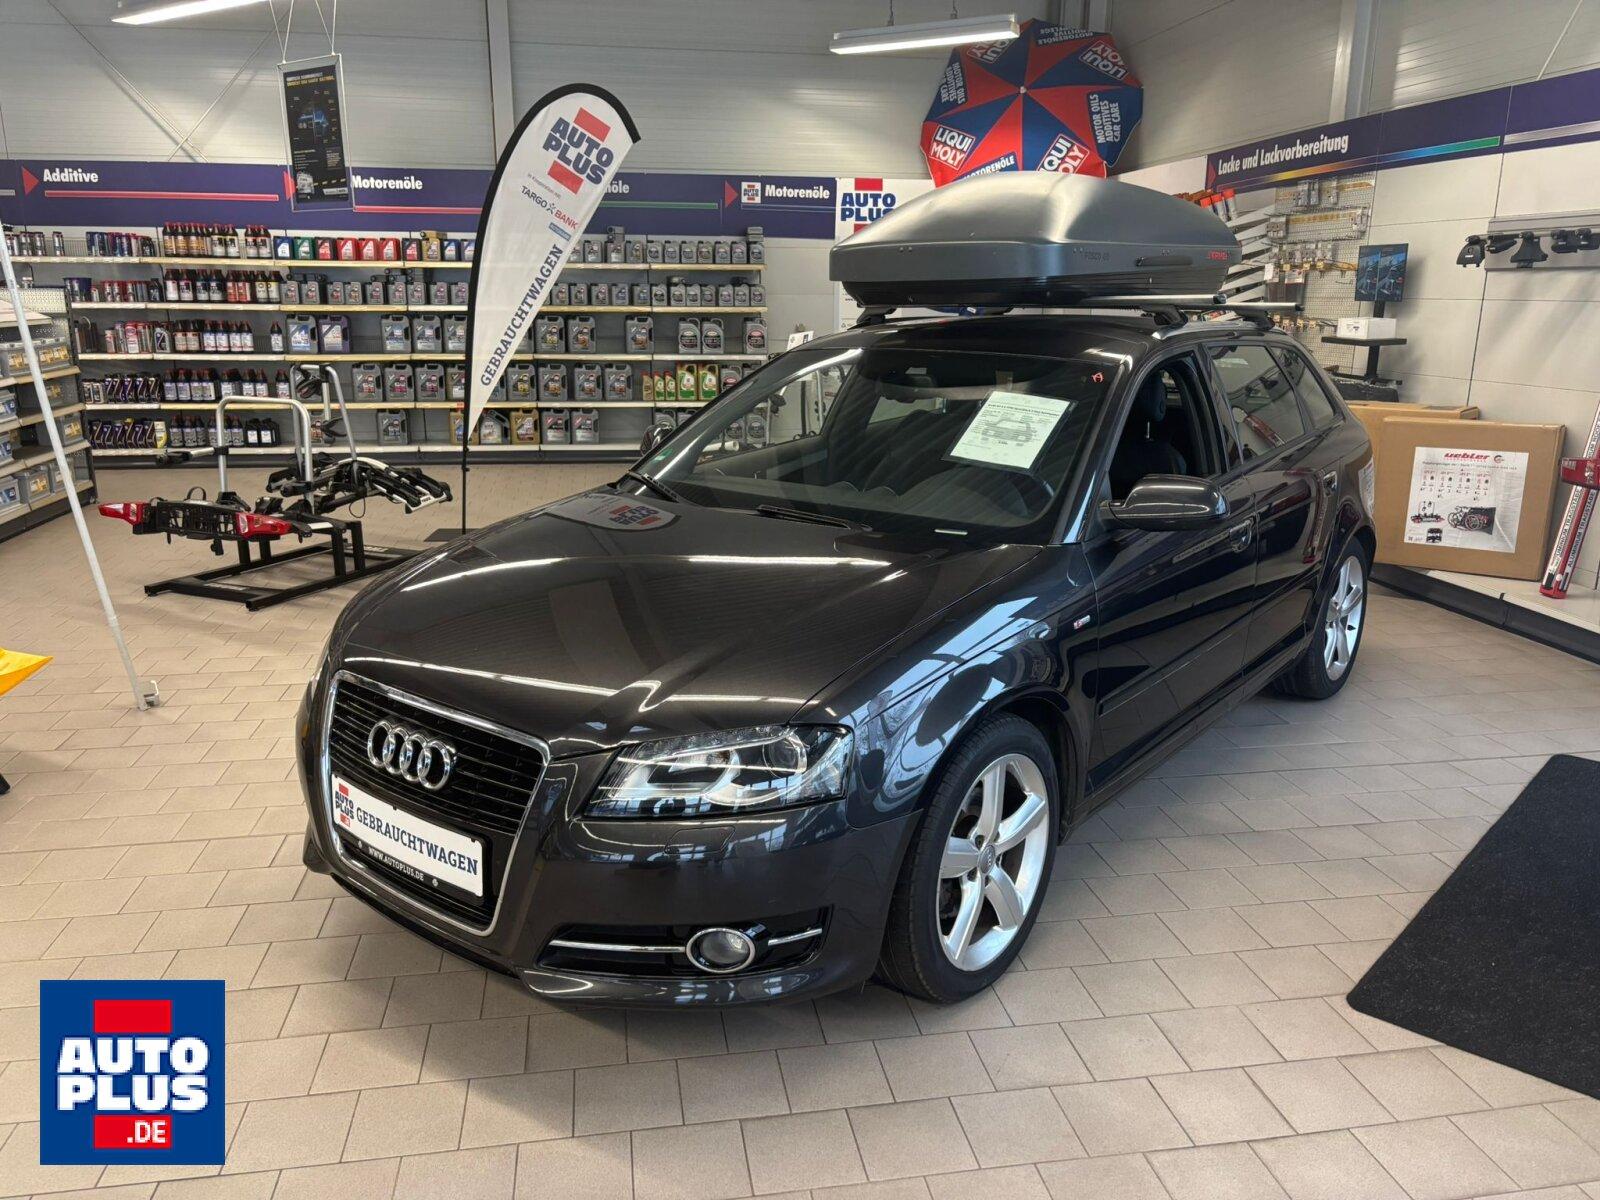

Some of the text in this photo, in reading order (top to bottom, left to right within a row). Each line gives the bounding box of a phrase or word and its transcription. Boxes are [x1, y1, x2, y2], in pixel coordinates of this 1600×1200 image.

[1083, 51, 1128, 78] LIQUI
[952, 62, 966, 104] MOTOR OILS
[1089, 93, 1107, 143] MOTOR OILS
[1100, 100, 1114, 142] ADDITIVES
[1109, 102, 1121, 142] CAR CARE
[551, 117, 614, 168] AUTO
[930, 142, 966, 167] MOLY
[934, 127, 972, 150] LIQUI
[1218, 134, 1349, 175] Lacke und Lackvorbereitung
[43, 168, 99, 183] Additive
[542, 132, 607, 185] PLUS
[1058, 145, 1085, 174] OLY
[351, 175, 423, 190] Motorenöle
[765, 185, 830, 199] Motorenöle
[841, 193, 897, 207] AUTO
[521, 185, 579, 230] TARGO BANK
[480, 244, 564, 387] GEBRAUCHTWAGEN
[1443, 452, 1490, 460] uebler
[1568, 530, 1582, 567] ALUMINIUM
[335, 791, 354, 809] AUTO
[335, 800, 355, 819] PLUS
[356, 807, 478, 875] GEBRAUCHTWAGEN
[368, 846, 425, 881] WWW.AUTOPLUS.DE
